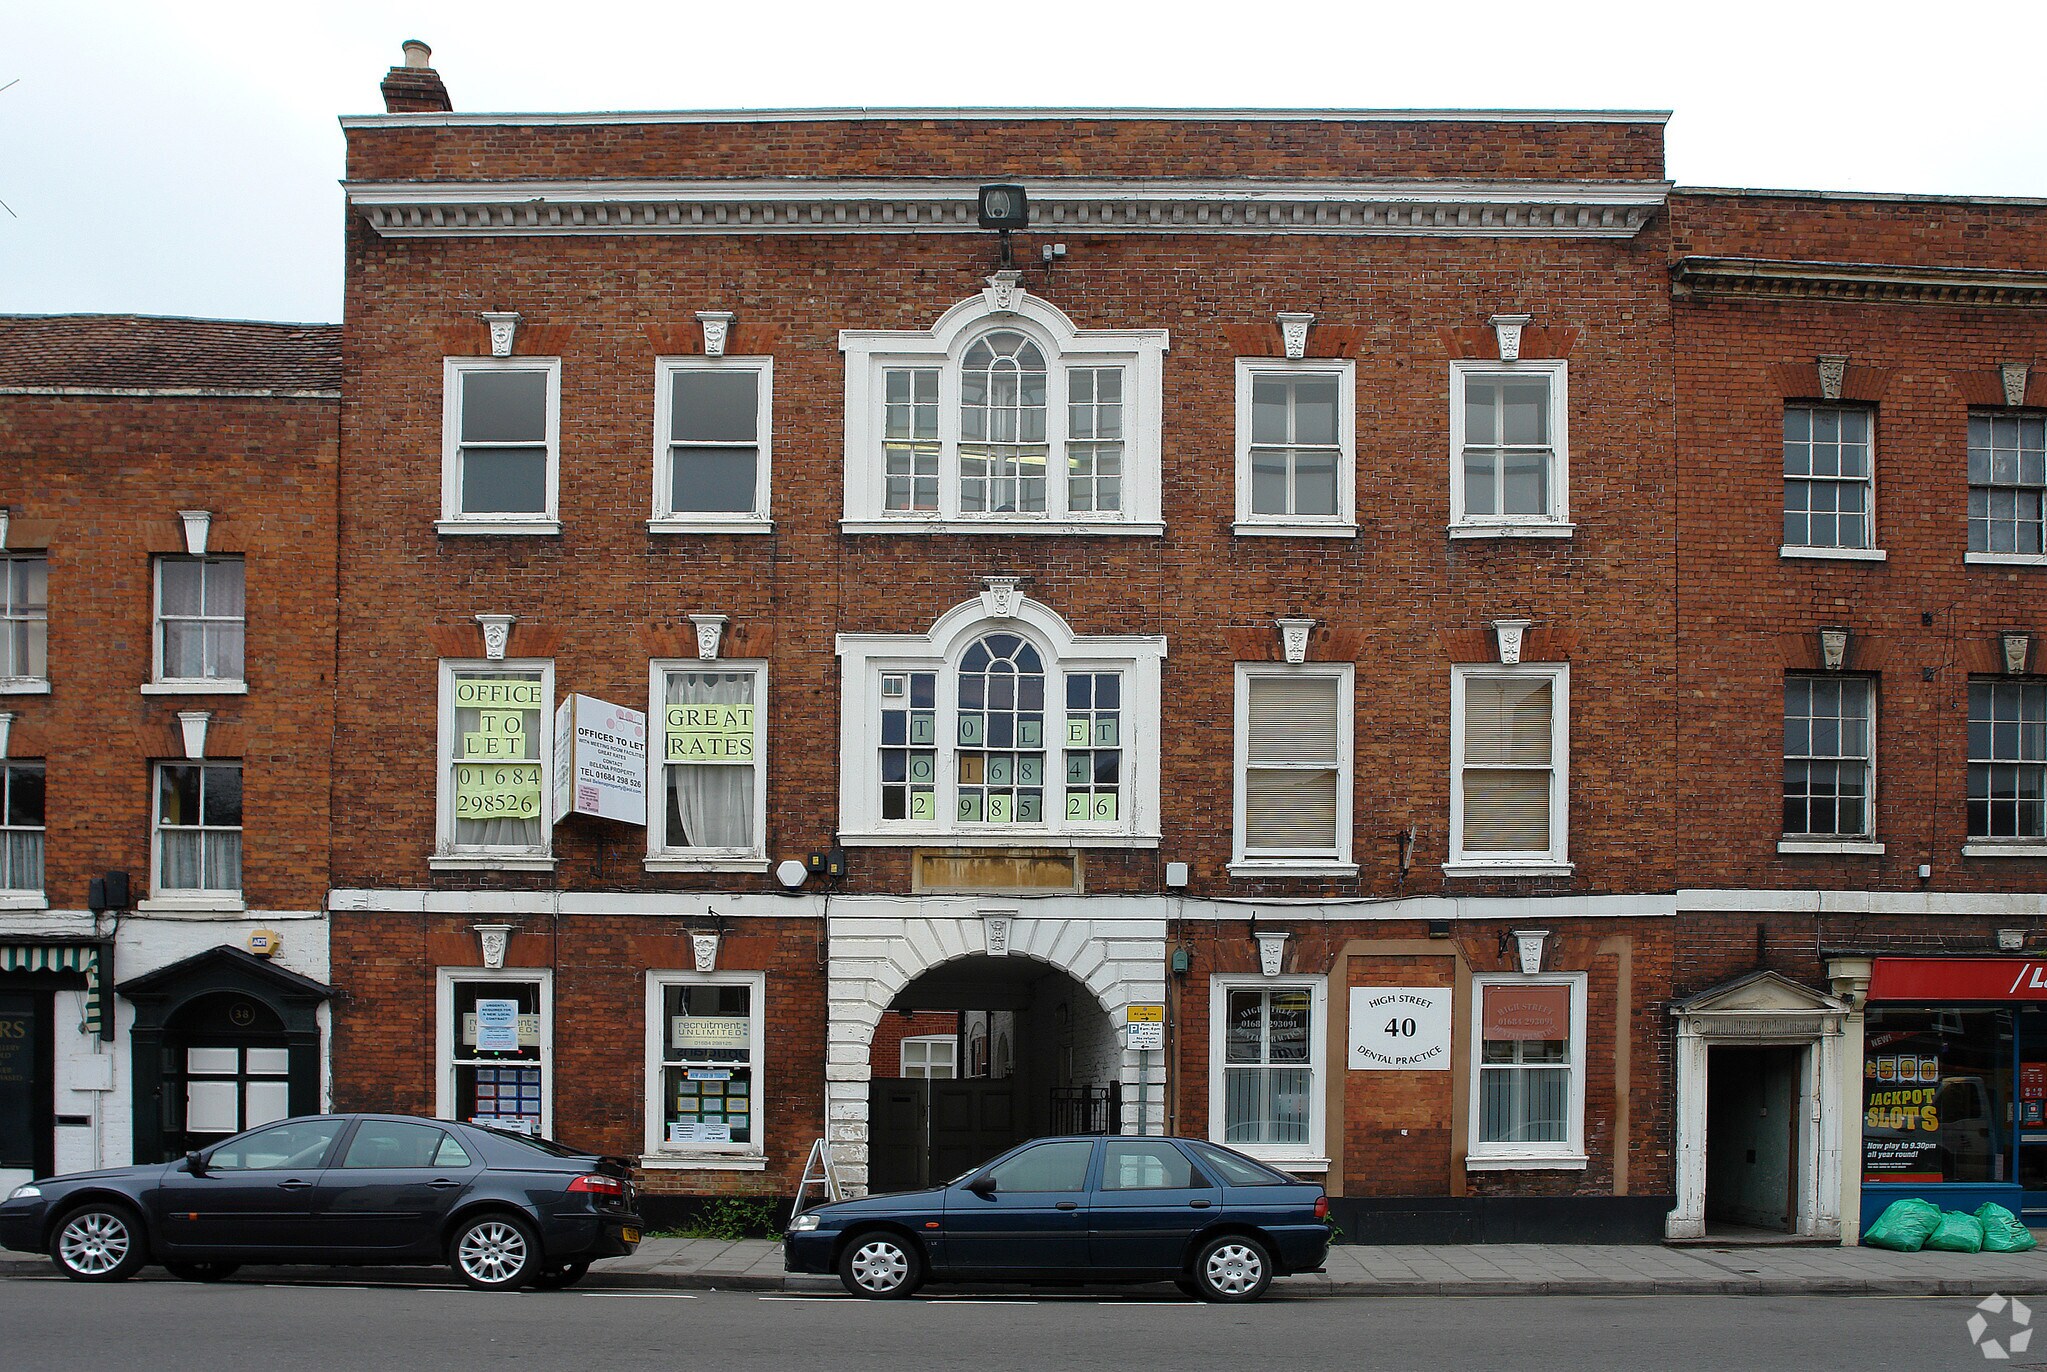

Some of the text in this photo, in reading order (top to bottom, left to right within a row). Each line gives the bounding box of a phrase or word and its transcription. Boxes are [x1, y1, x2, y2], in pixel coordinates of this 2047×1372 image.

[457, 683, 542, 704] OFFICE
[482, 715, 522, 734] TO
[667, 708, 753, 728] GREAT
[466, 737, 521, 755] LET
[578, 727, 644, 751] OFFICES TO LET
[591, 740, 610, 750] MEETING
[610, 745, 623, 753] ROOM
[670, 737, 753, 756] RATES
[597, 749, 612, 757] GREAT
[602, 758, 623, 767] CONTACT
[459, 767, 541, 786] 01684
[580, 767, 642, 788] TEL 01684 298 526
[459, 794, 533, 813] 298526
[1369, 994, 1433, 1008] HIGH STREET
[235, 1009, 249, 1019] 38
[678, 1020, 741, 1029] recruitment
[1241, 1020, 1263, 1028] 0168
[1384, 1018, 1417, 1037] 40
[1871, 1033, 1893, 1048] NEW!
[1357, 1045, 1442, 1065] DENTAL PRACTICE
[1870, 1088, 1936, 1106] JACKPOT
[1867, 1106, 1939, 1132] SLOTS
[1867, 1142, 1937, 1151] Now play to 9.30pm
[1878, 1152, 1894, 1160] year
[1895, 1150, 1919, 1158] round!
